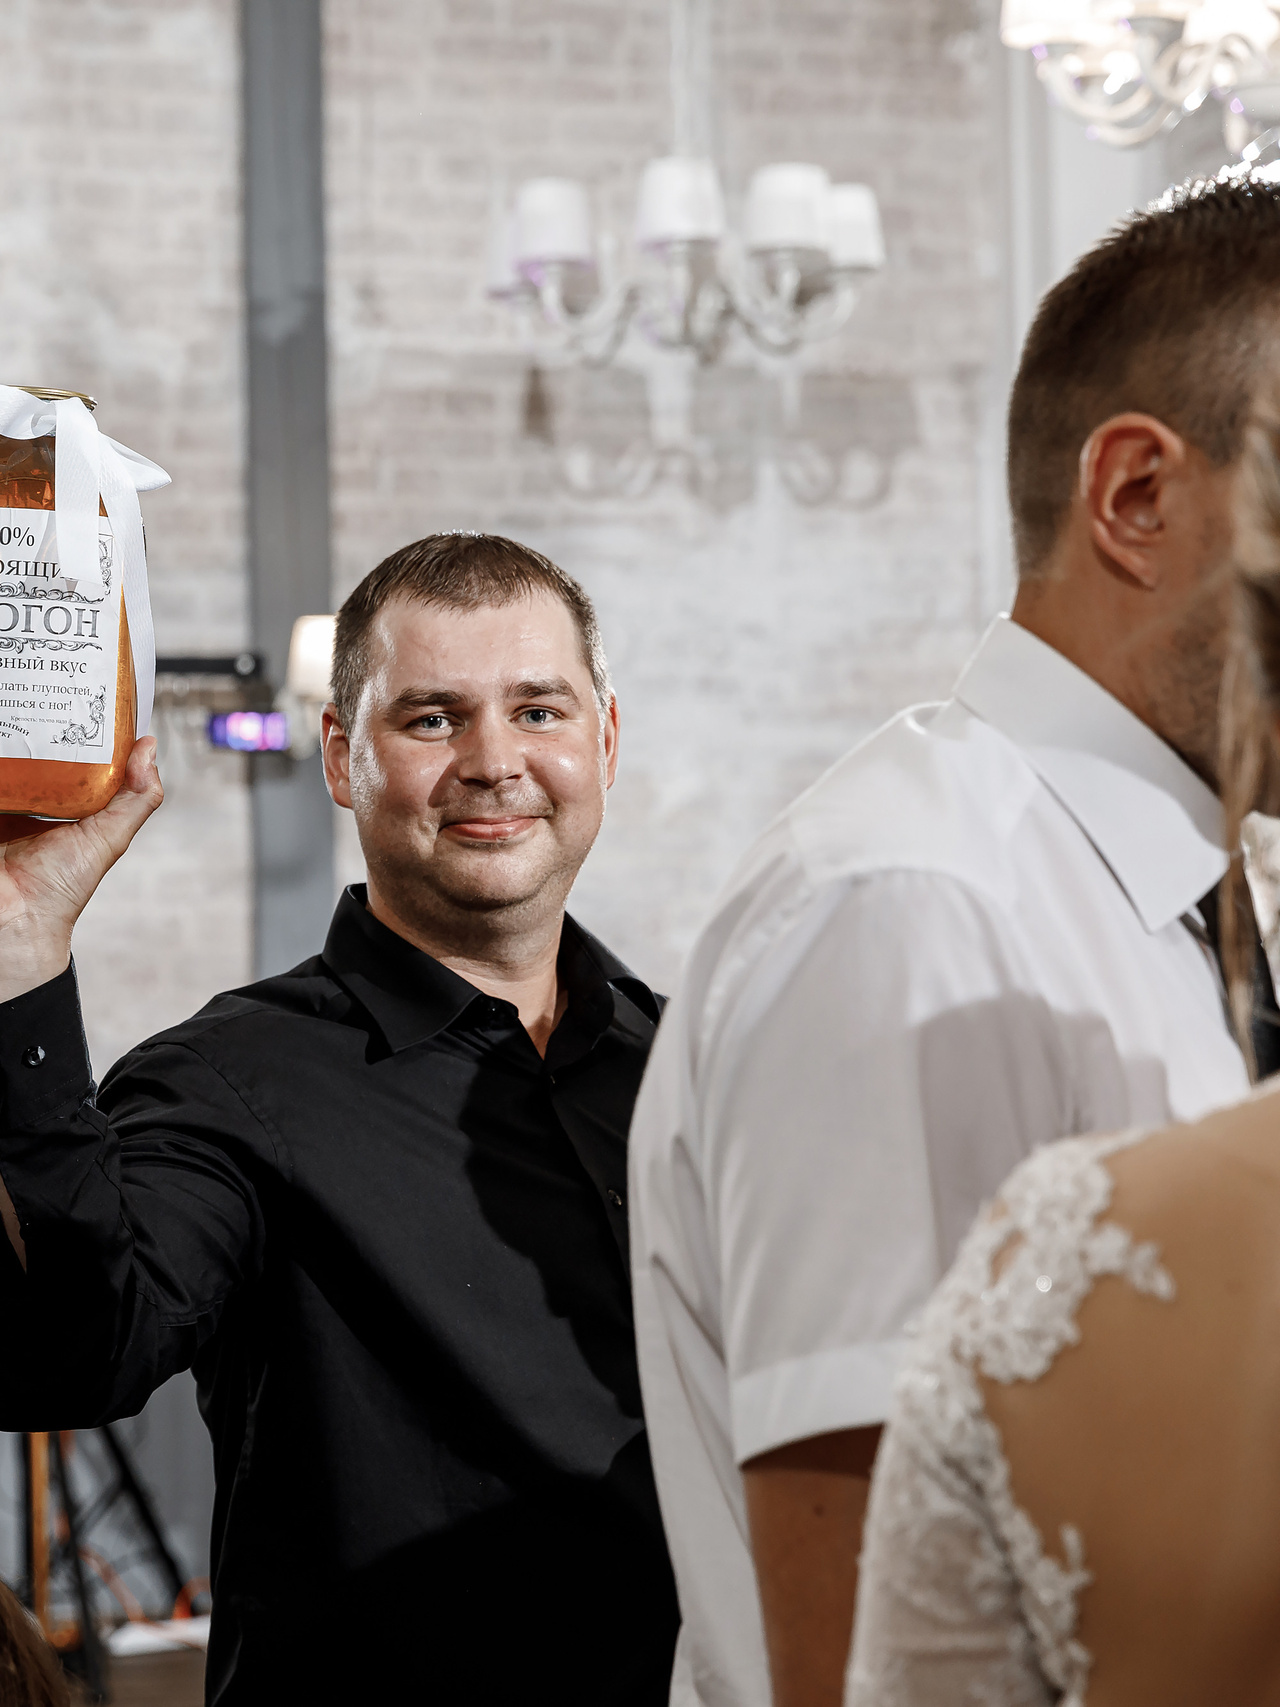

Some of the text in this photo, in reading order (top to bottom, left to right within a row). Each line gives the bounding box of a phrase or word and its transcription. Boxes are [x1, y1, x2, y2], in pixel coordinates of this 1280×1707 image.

[50, 659, 87, 678] вкус
[32, 684, 93, 698] глупостей,
[38, 701, 46, 710] с
[48, 700, 72, 711] ног!
